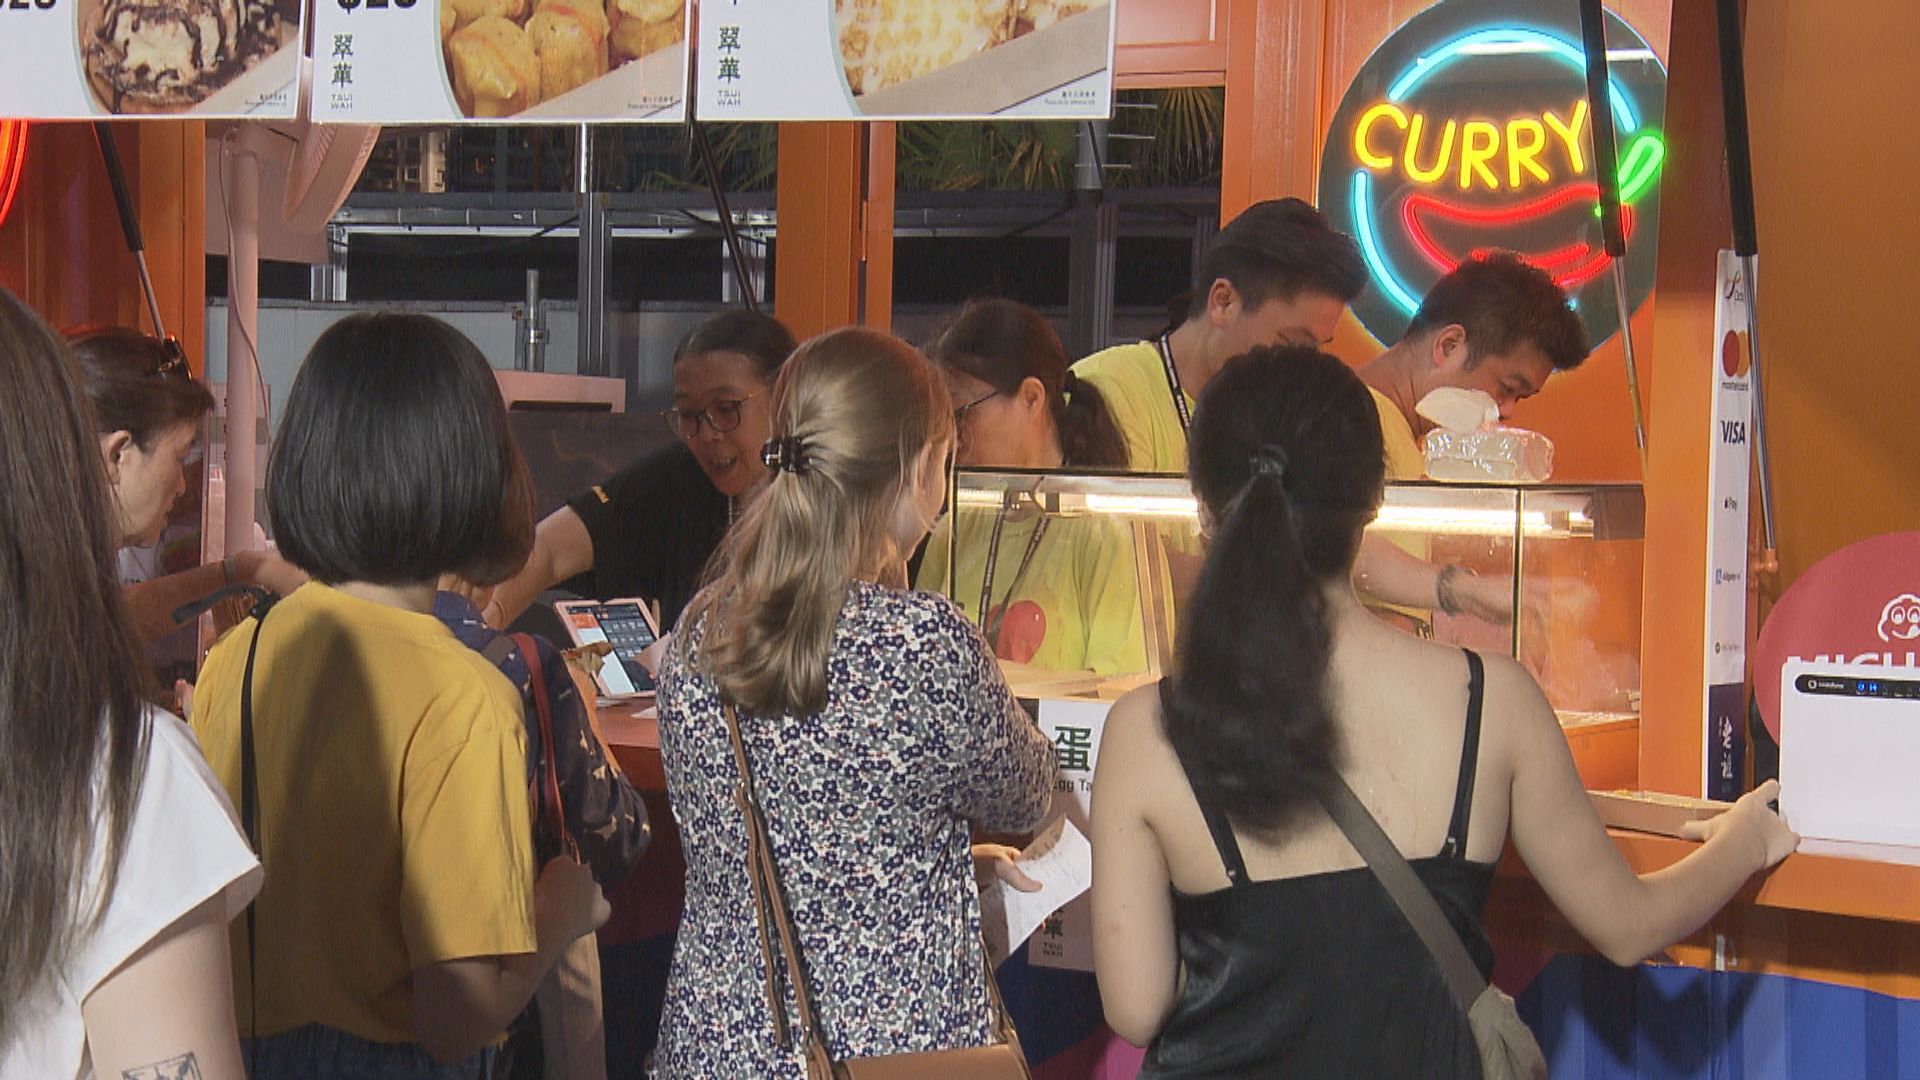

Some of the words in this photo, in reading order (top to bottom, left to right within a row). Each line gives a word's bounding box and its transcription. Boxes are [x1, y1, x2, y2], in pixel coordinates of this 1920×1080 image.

[332, 33, 354, 89] 翠華
[718, 26, 741, 84] 翠華
[1354, 101, 1588, 189] CURRY
[1720, 420, 1746, 444] VISA
[1055, 726, 1091, 772] 蛋
